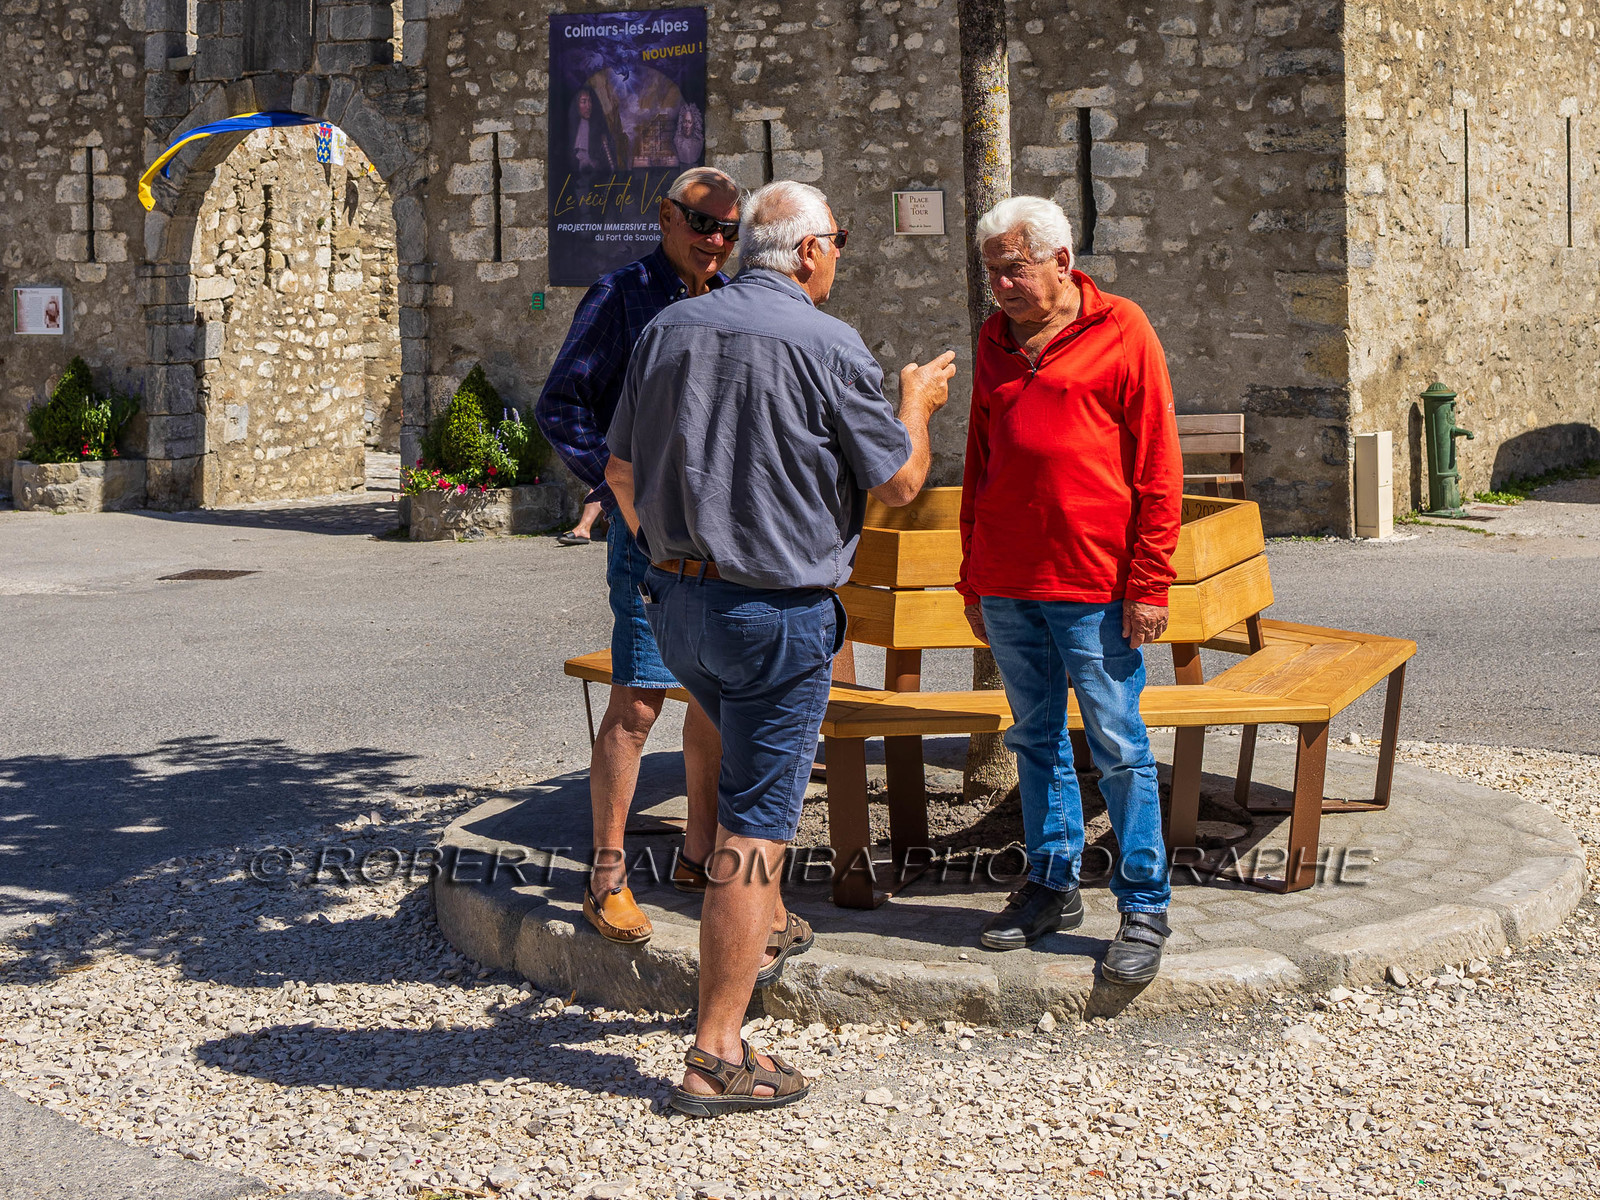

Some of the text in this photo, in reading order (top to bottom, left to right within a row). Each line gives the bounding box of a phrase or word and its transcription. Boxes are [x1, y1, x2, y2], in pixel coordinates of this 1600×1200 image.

[564, 19, 689, 39] Colmars-les-Alpes
[642, 43, 695, 61] NOUVEAU
[554, 174, 574, 216] Le
[579, 174, 617, 214] récit
[615, 175, 633, 213] de
[557, 223, 602, 232] PROJECTION
[603, 223, 647, 231] IMMERSIVE
[595, 233, 661, 241] du Fort de Savoie
